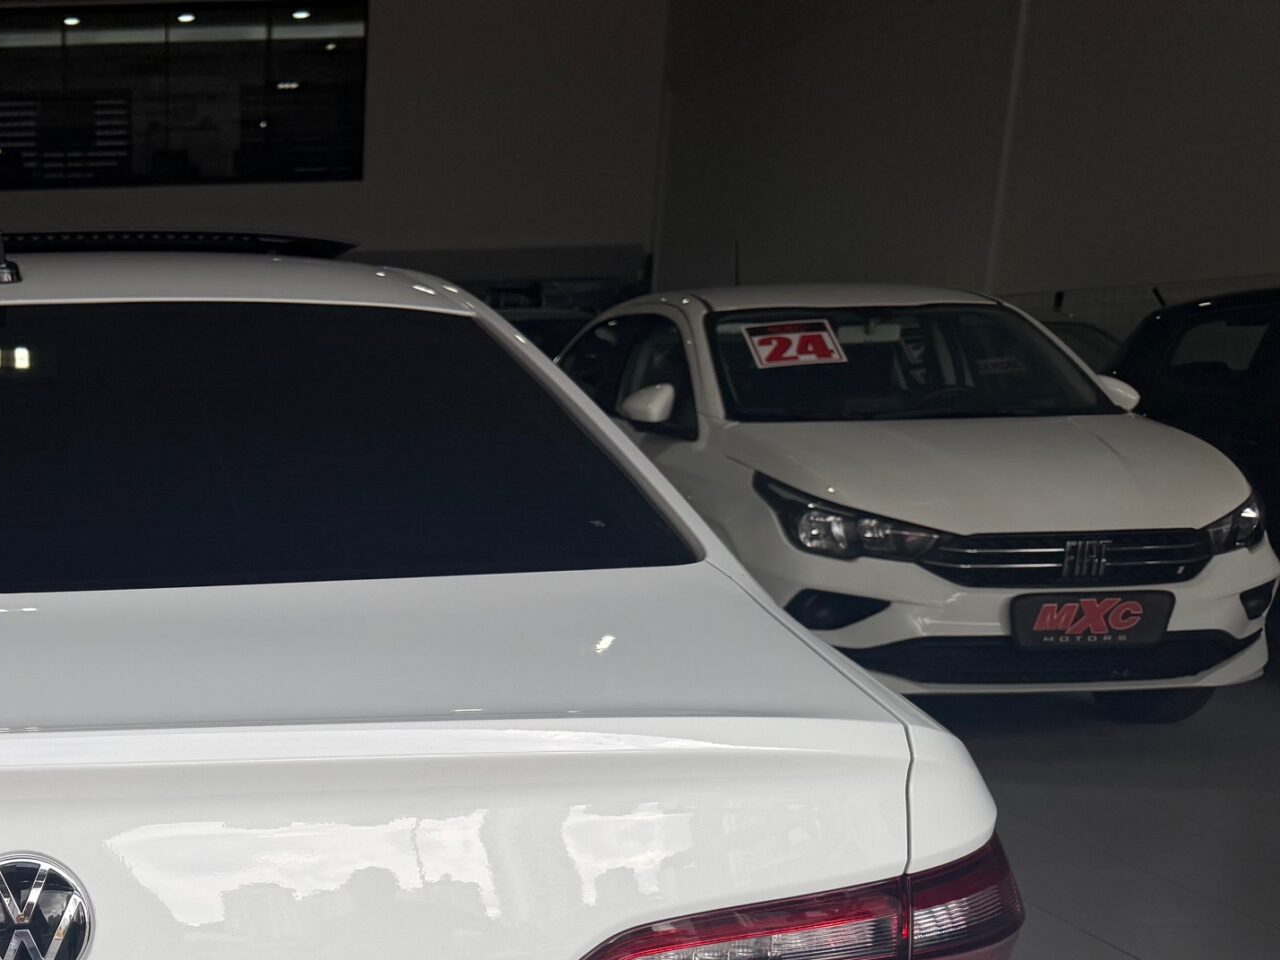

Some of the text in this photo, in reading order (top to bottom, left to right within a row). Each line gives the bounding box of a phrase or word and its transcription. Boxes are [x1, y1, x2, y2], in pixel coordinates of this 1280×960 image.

[757, 333, 834, 364] 24
[1062, 539, 1113, 577] FIAT
[1033, 598, 1143, 634] MXC
